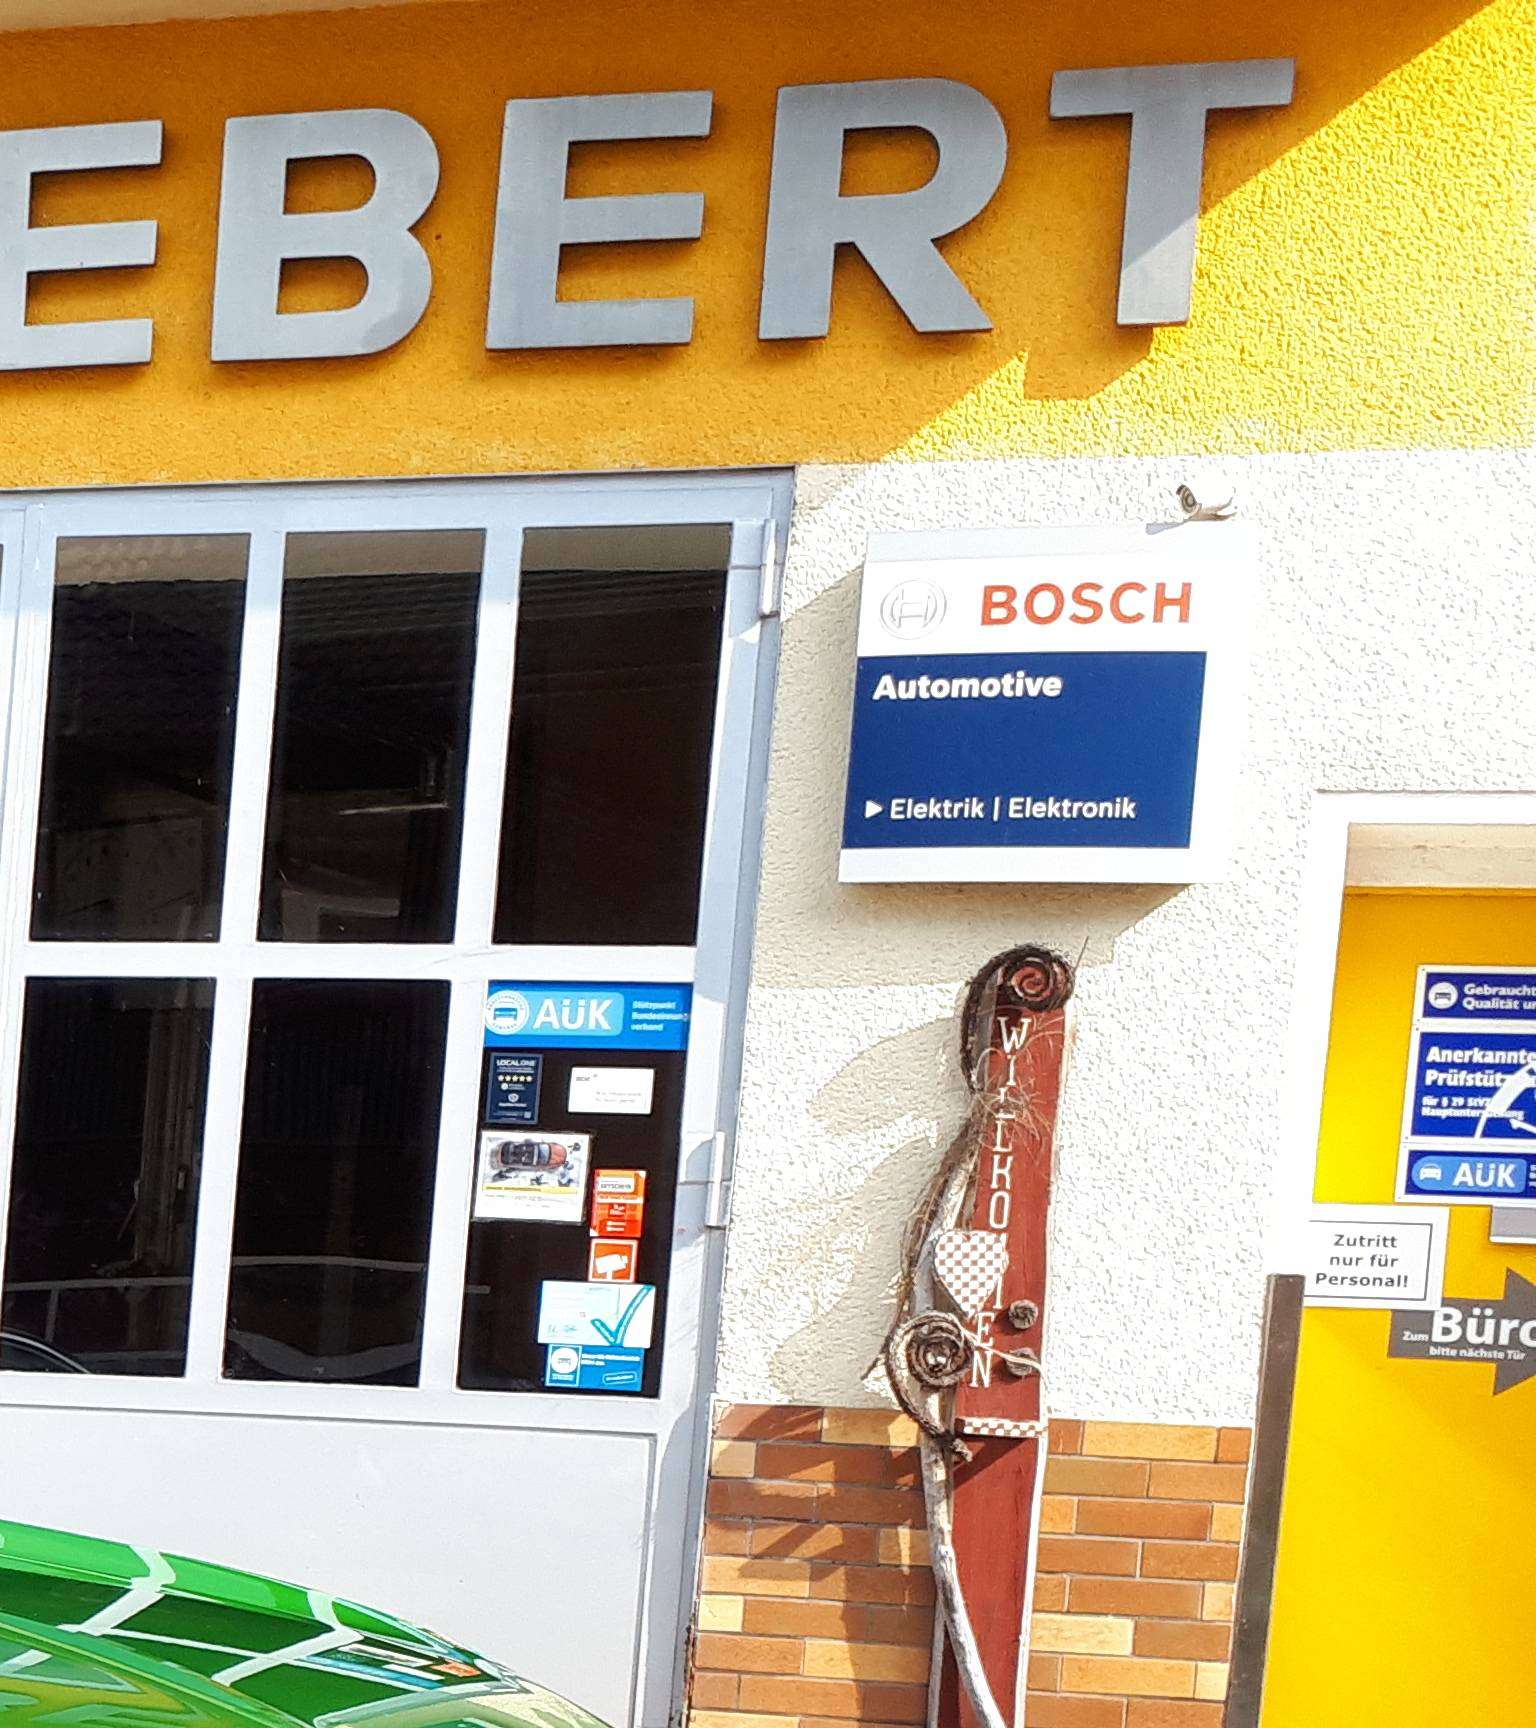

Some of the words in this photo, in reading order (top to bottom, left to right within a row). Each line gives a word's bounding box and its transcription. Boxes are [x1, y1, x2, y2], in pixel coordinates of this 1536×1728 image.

[980, 581, 1193, 627] BOSCH
[872, 670, 1064, 701] Automotive
[889, 796, 985, 820] Elektrik
[1008, 796, 1137, 820] Elektronik
[1462, 996, 1520, 1011] Qualität
[532, 998, 614, 1031] AÜK
[1452, 1161, 1516, 1188] AÜK
[969, 1015, 1031, 1388] WILLKOEN
[1333, 1234, 1399, 1248] Zutritt
[1330, 1256, 1363, 1267] nur
[1370, 1254, 1399, 1268] für
[1315, 1272, 1409, 1288] Personal!
[1402, 1330, 1429, 1342] Zum
[1429, 1345, 1458, 1357] bitte
[1459, 1346, 1505, 1360] nächste
[1506, 1349, 1527, 1361] Tür
